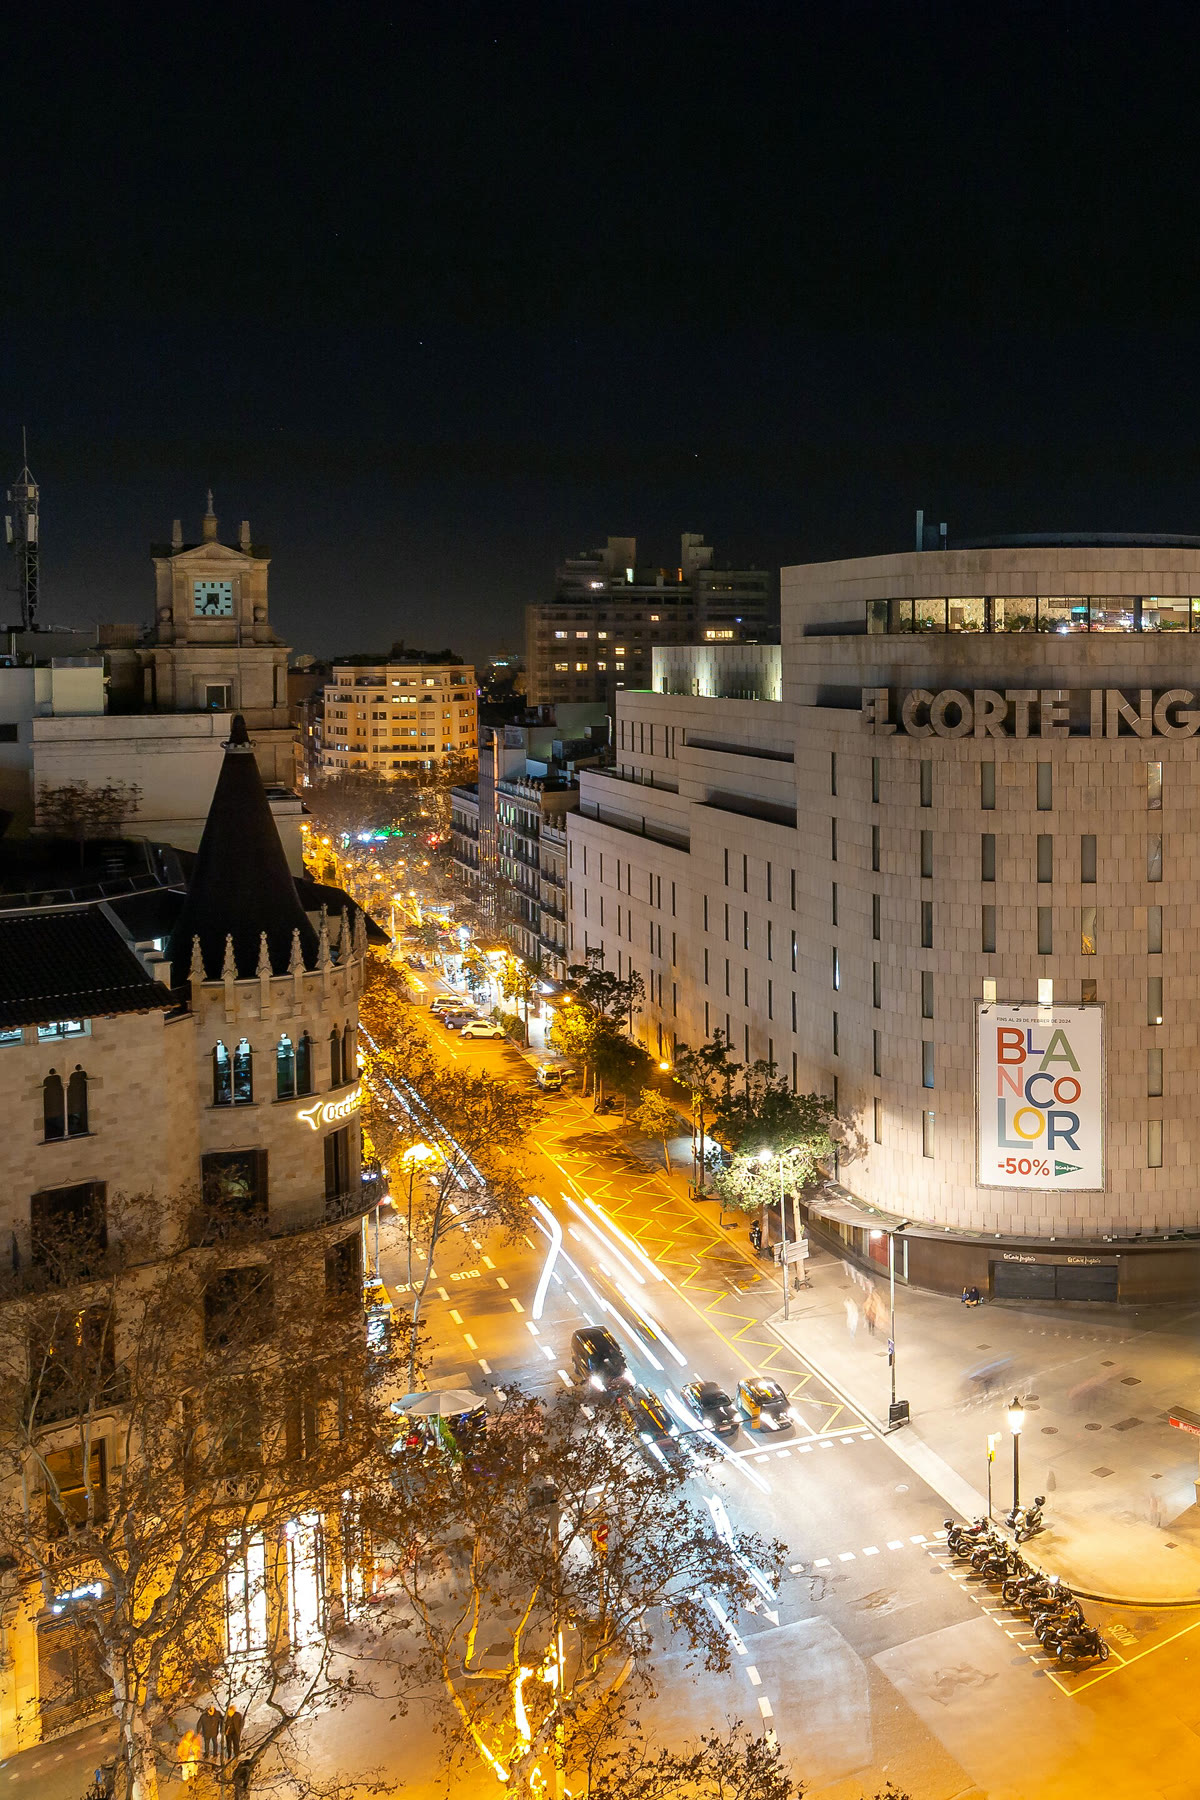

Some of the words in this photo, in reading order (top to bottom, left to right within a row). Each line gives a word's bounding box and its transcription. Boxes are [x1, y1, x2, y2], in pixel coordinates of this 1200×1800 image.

[861, 689, 897, 735] EL
[902, 689, 1069, 738] CORTE
[998, 1158, 1050, 1176] -50%
[450, 1270, 481, 1281] BUS
